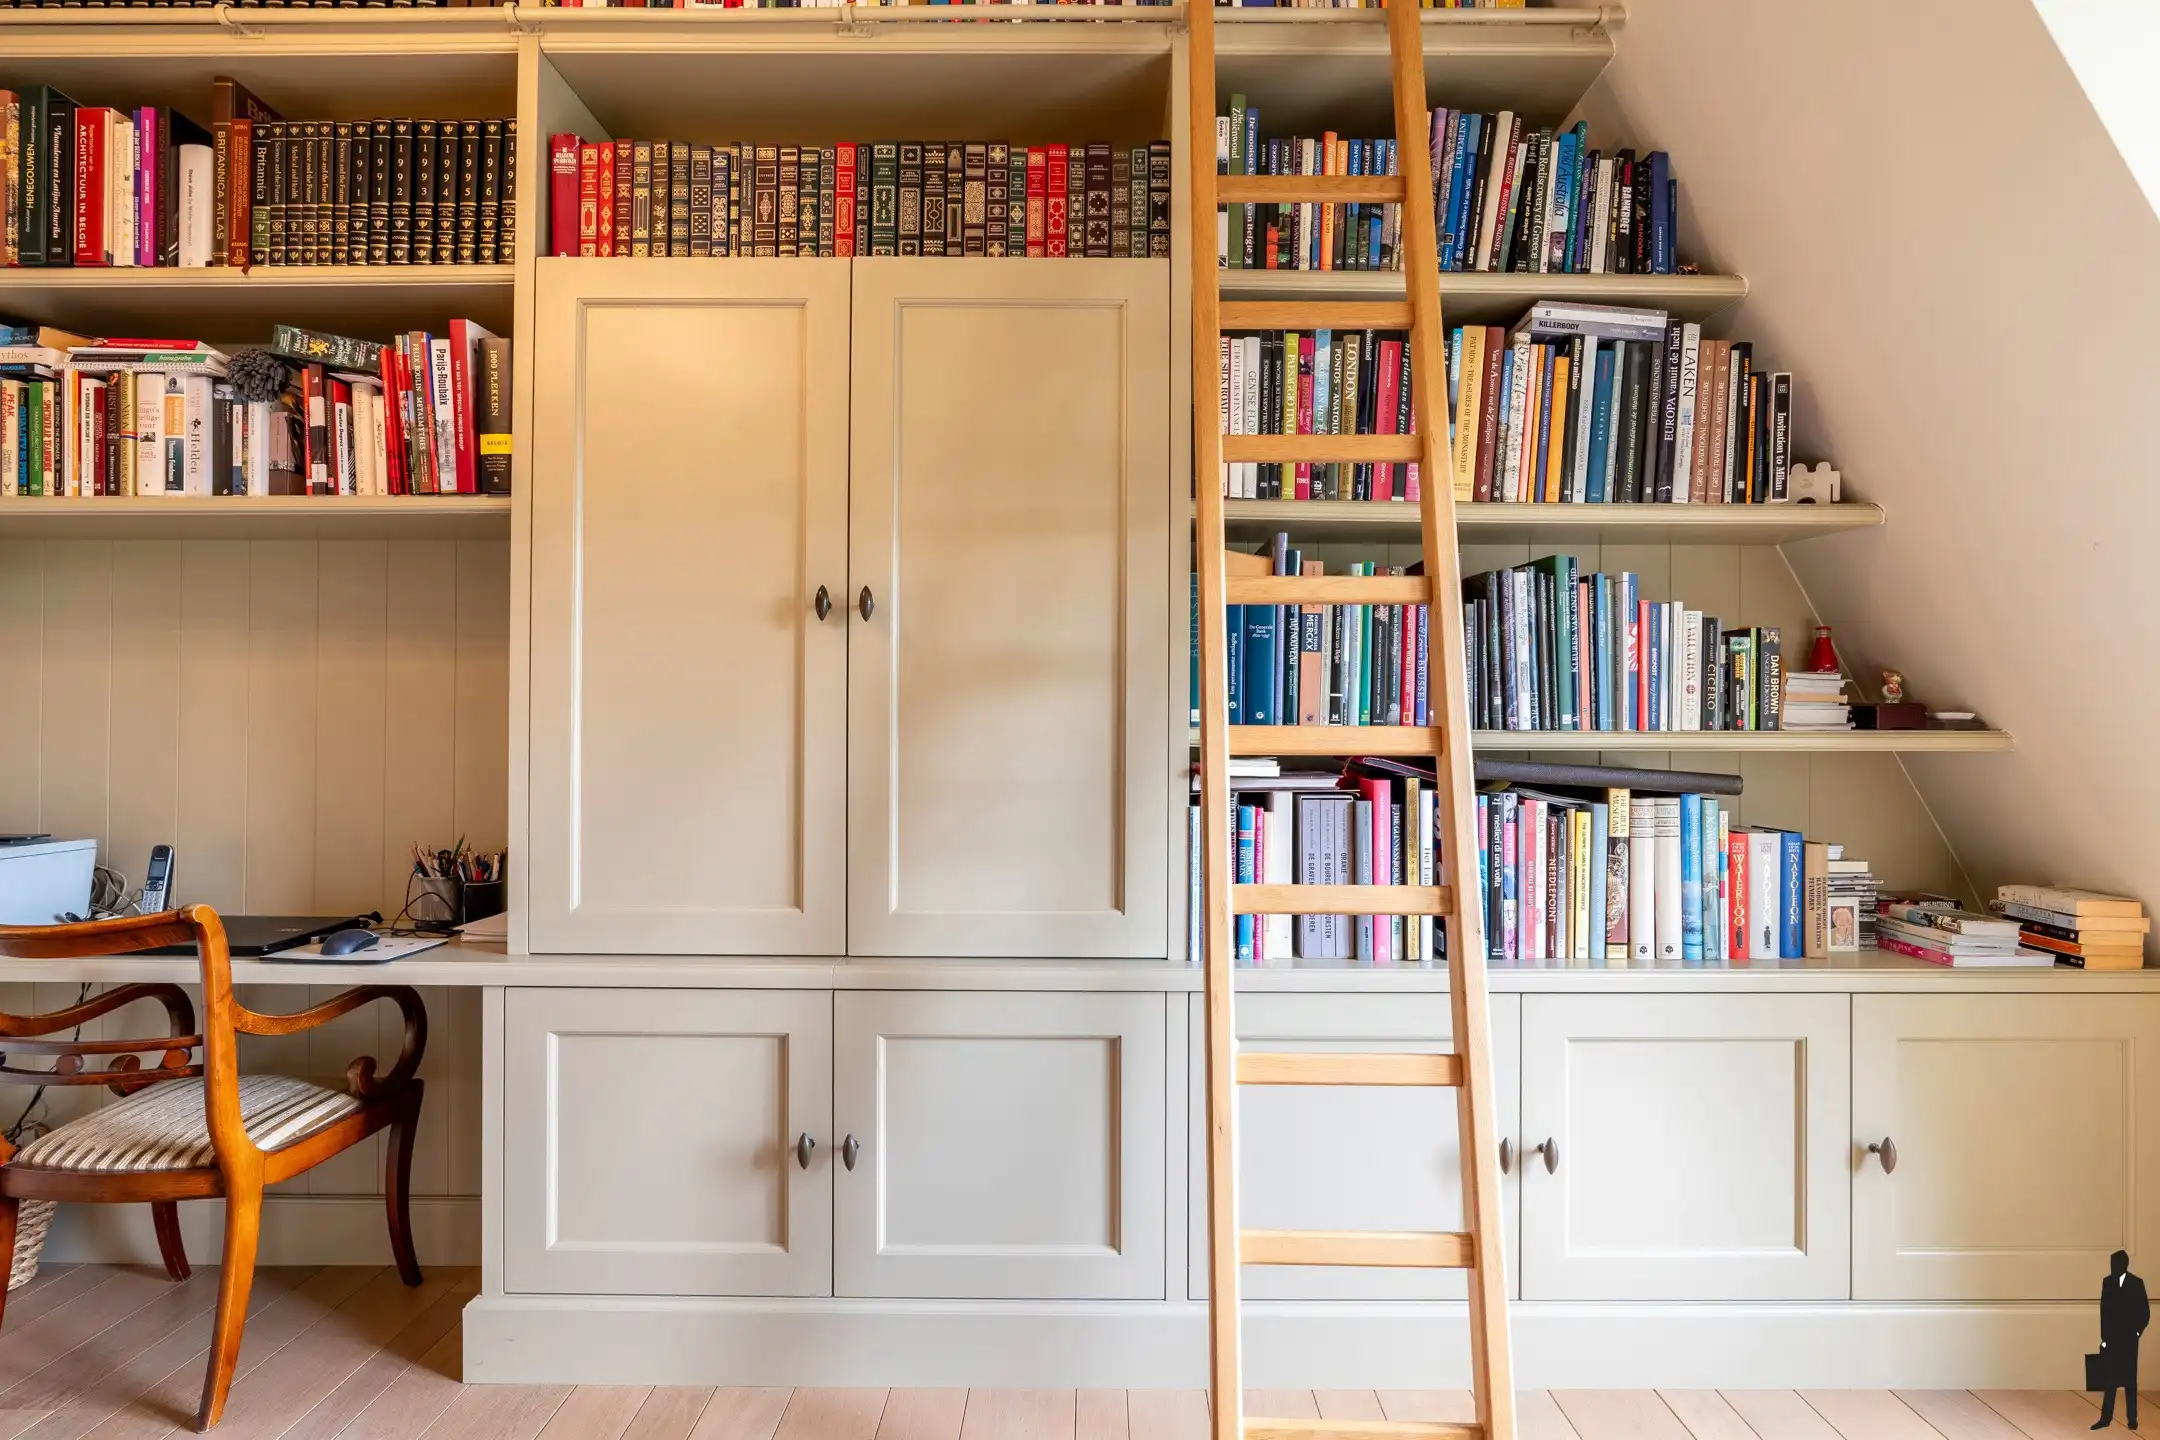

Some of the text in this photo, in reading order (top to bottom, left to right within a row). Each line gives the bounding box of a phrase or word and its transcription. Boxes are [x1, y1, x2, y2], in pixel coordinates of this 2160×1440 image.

[52, 125, 61, 168] Vlaanderen
[1232, 108, 1241, 158] Zoniënwoud
[1248, 117, 1256, 166] De mooiste
[1455, 118, 1466, 160] CREMLINO
[1510, 118, 1521, 153] BRUXELLES
[26, 144, 34, 208] HENEGOUWEN
[216, 131, 226, 240] BRITANNICA ATLAS
[256, 147, 267, 200] Britannica
[464, 144, 472, 196] 1995
[486, 144, 494, 196] 1996
[1504, 158, 1514, 186] BRUSSEL
[1554, 168, 1570, 216] Australia
[79, 203, 86, 212] IN
[1500, 188, 1510, 220] BRUSSELS
[1531, 138, 1550, 259] The Rediscovery of Greece
[1620, 186, 1632, 234] BANKROET
[78, 216, 88, 248] BELGIË
[1538, 320, 1580, 330] KILLERBODY
[1334, 348, 1342, 384] PONTOS
[1346, 342, 1358, 400] LONDON
[1402, 358, 1410, 384] gelaat
[1468, 336, 1476, 364] PATMOS
[436, 348, 448, 406] Parijs-Roubaix
[490, 350, 499, 416] 1000 PLEKKEN
[1247, 371, 1256, 406] GENTSE
[1287, 354, 1296, 406] PAESAGGIO
[1465, 370, 1474, 408] TREASURES
[1664, 327, 1680, 440] EUROPA vanuit de lucht
[1683, 348, 1696, 398] LAKEN
[1464, 408, 1472, 417] OF
[1485, 349, 1499, 444] Van Azoren Zuidpool
[1701, 380, 1710, 424] ARCHITECTURE
[1716, 382, 1724, 424] ARCHITECTURE
[190, 434, 200, 474] Helden
[1460, 434, 1470, 474] MONASTERY
[1698, 426, 1706, 466] TRADITIONAL
[1714, 427, 1722, 466] TRADITIONAL
[1776, 412, 1786, 490] Invitation to Milan
[1626, 484, 1632, 492] Le
[1306, 614, 1314, 650] MERCKX
[1686, 626, 1696, 680] VALUATION
[1418, 660, 1426, 703] BRUSSEL
[1707, 664, 1716, 710] CICERO
[1770, 655, 1779, 714] DAN BROWN
[1308, 852, 1315, 860] DE
[1325, 852, 1332, 860] DE
[1340, 852, 1348, 874] ORANJE
[1548, 858, 1556, 924] NEEDLEPOINT
[1733, 854, 1746, 926] WATERLOO
[1763, 854, 1772, 926] NAPOLEON
[1790, 854, 1800, 925] NAPOLEON
